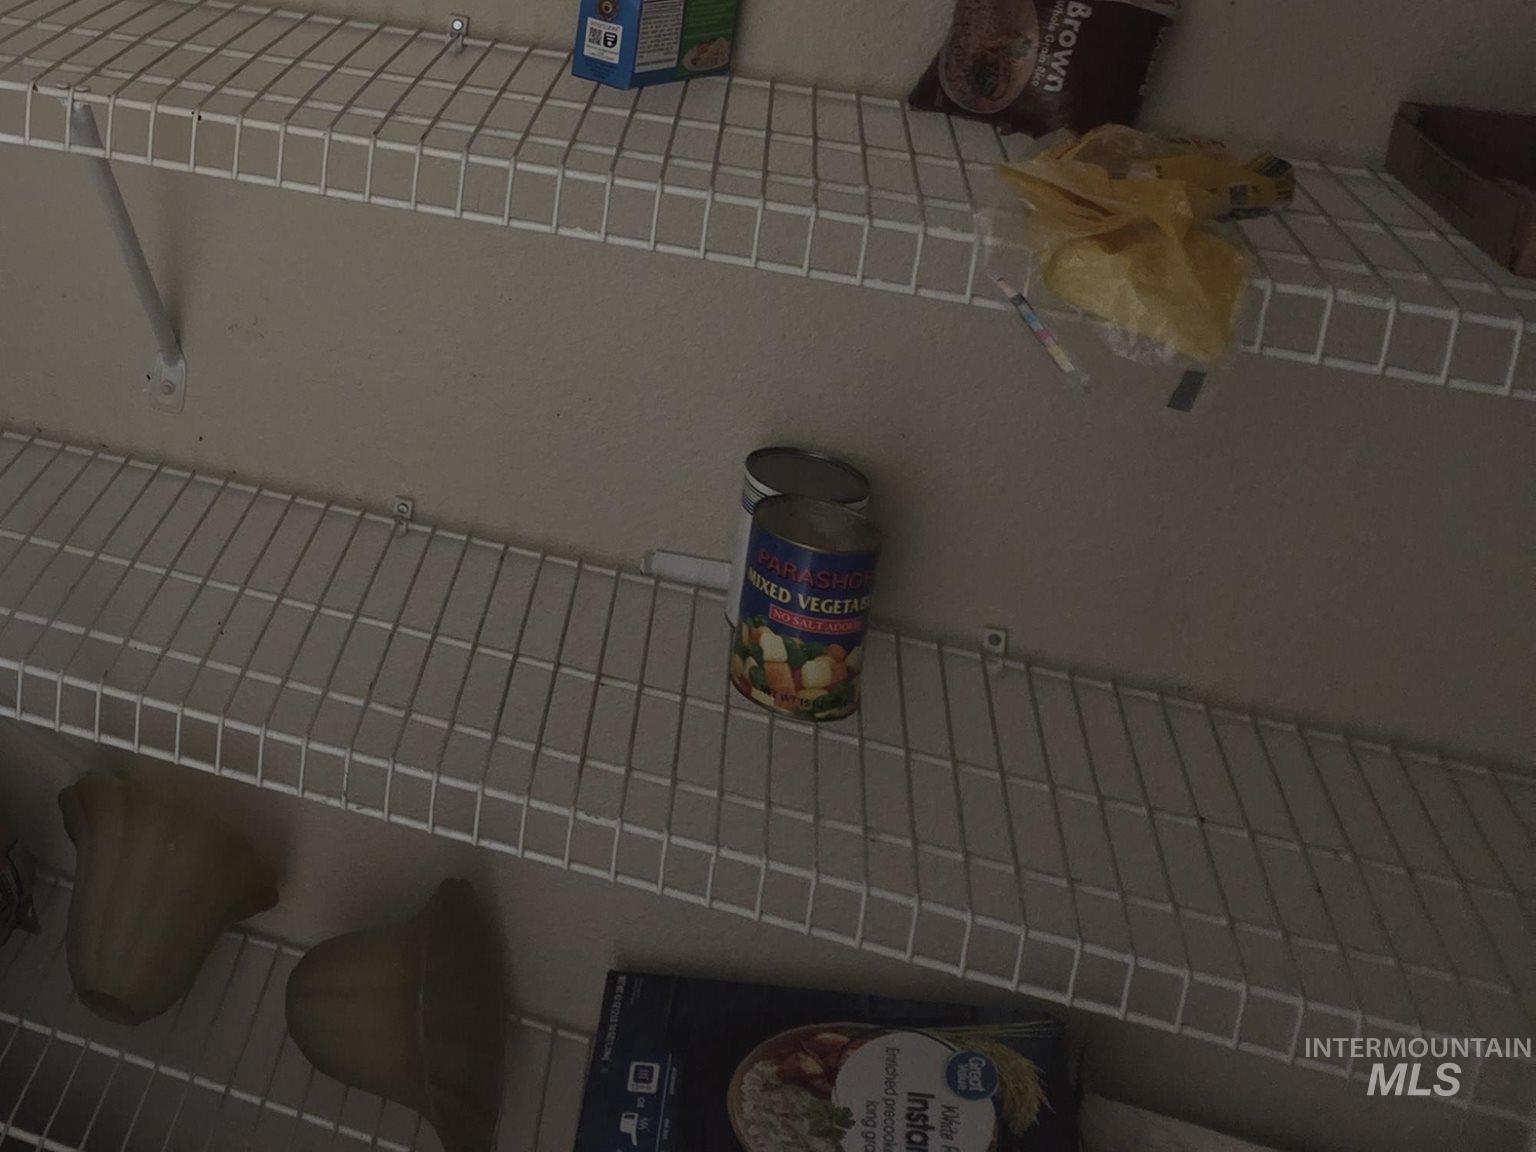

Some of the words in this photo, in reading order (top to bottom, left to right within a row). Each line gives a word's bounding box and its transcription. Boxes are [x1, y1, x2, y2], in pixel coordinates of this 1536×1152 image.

[1043, 0, 1093, 94] Brown
[747, 565, 792, 605] MIXED
[773, 609, 792, 624] NO
[792, 613, 825, 631] SALT
[884, 1046, 900, 1097] Enriched
[862, 1100, 879, 1129] long
